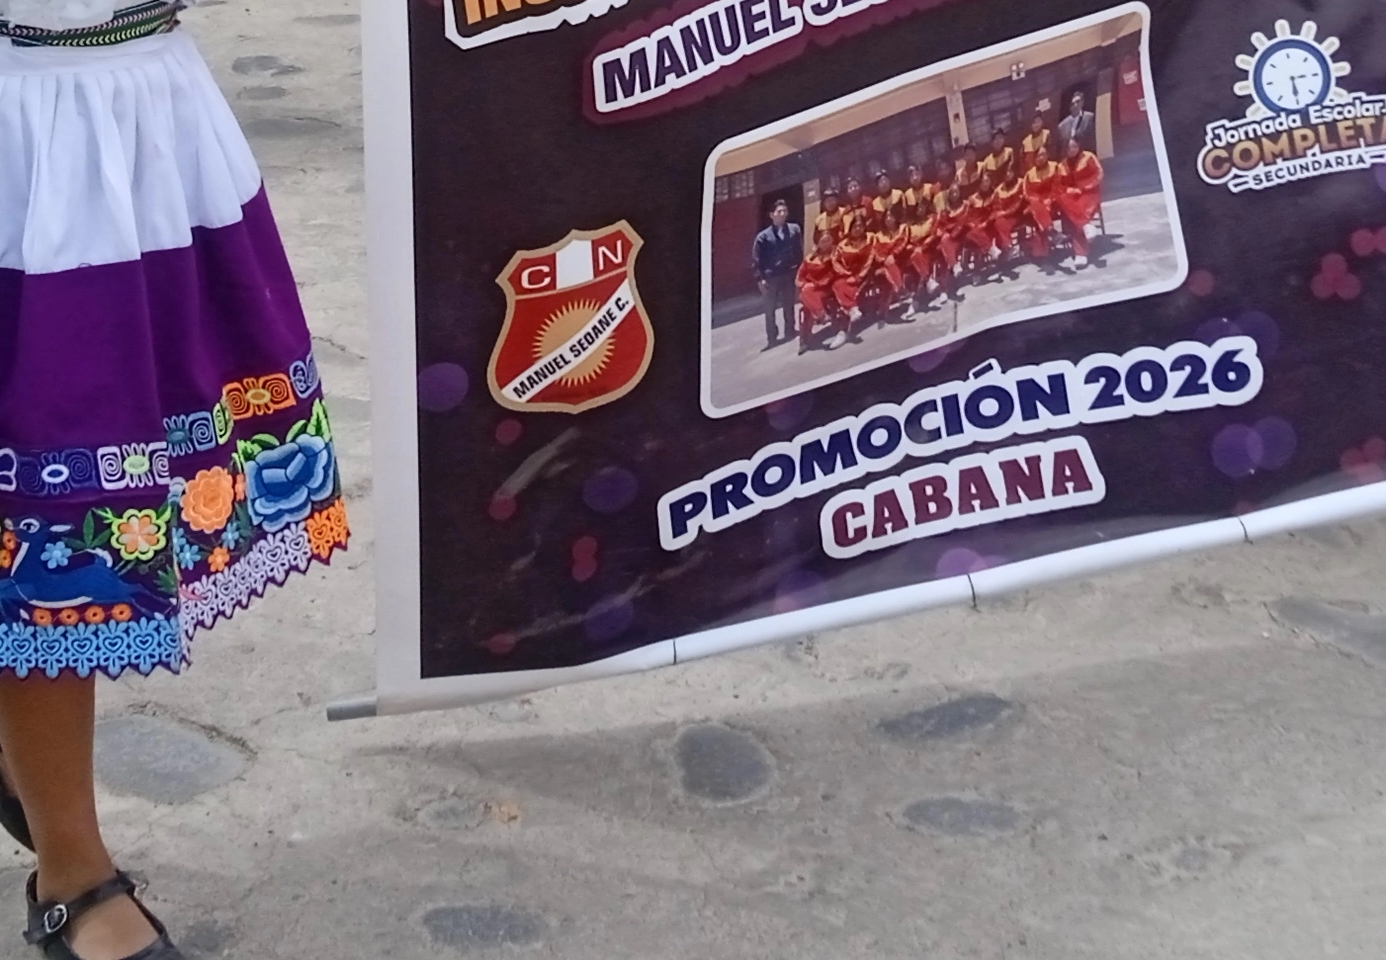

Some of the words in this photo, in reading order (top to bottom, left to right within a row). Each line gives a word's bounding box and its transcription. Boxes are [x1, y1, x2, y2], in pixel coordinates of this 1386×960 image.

[1213, 112, 1301, 147] Jornada
[1309, 99, 1386, 125] Escolar
[1252, 152, 1367, 187] SECUNDARIA
[521, 266, 552, 289] C
[598, 240, 623, 270] N
[512, 353, 572, 399] MANUEL
[569, 307, 618, 359] SEOANE
[668, 362, 1071, 540] PROMOCIÓN
[1085, 349, 1252, 411] 2026
[830, 448, 1093, 548] CABANA
